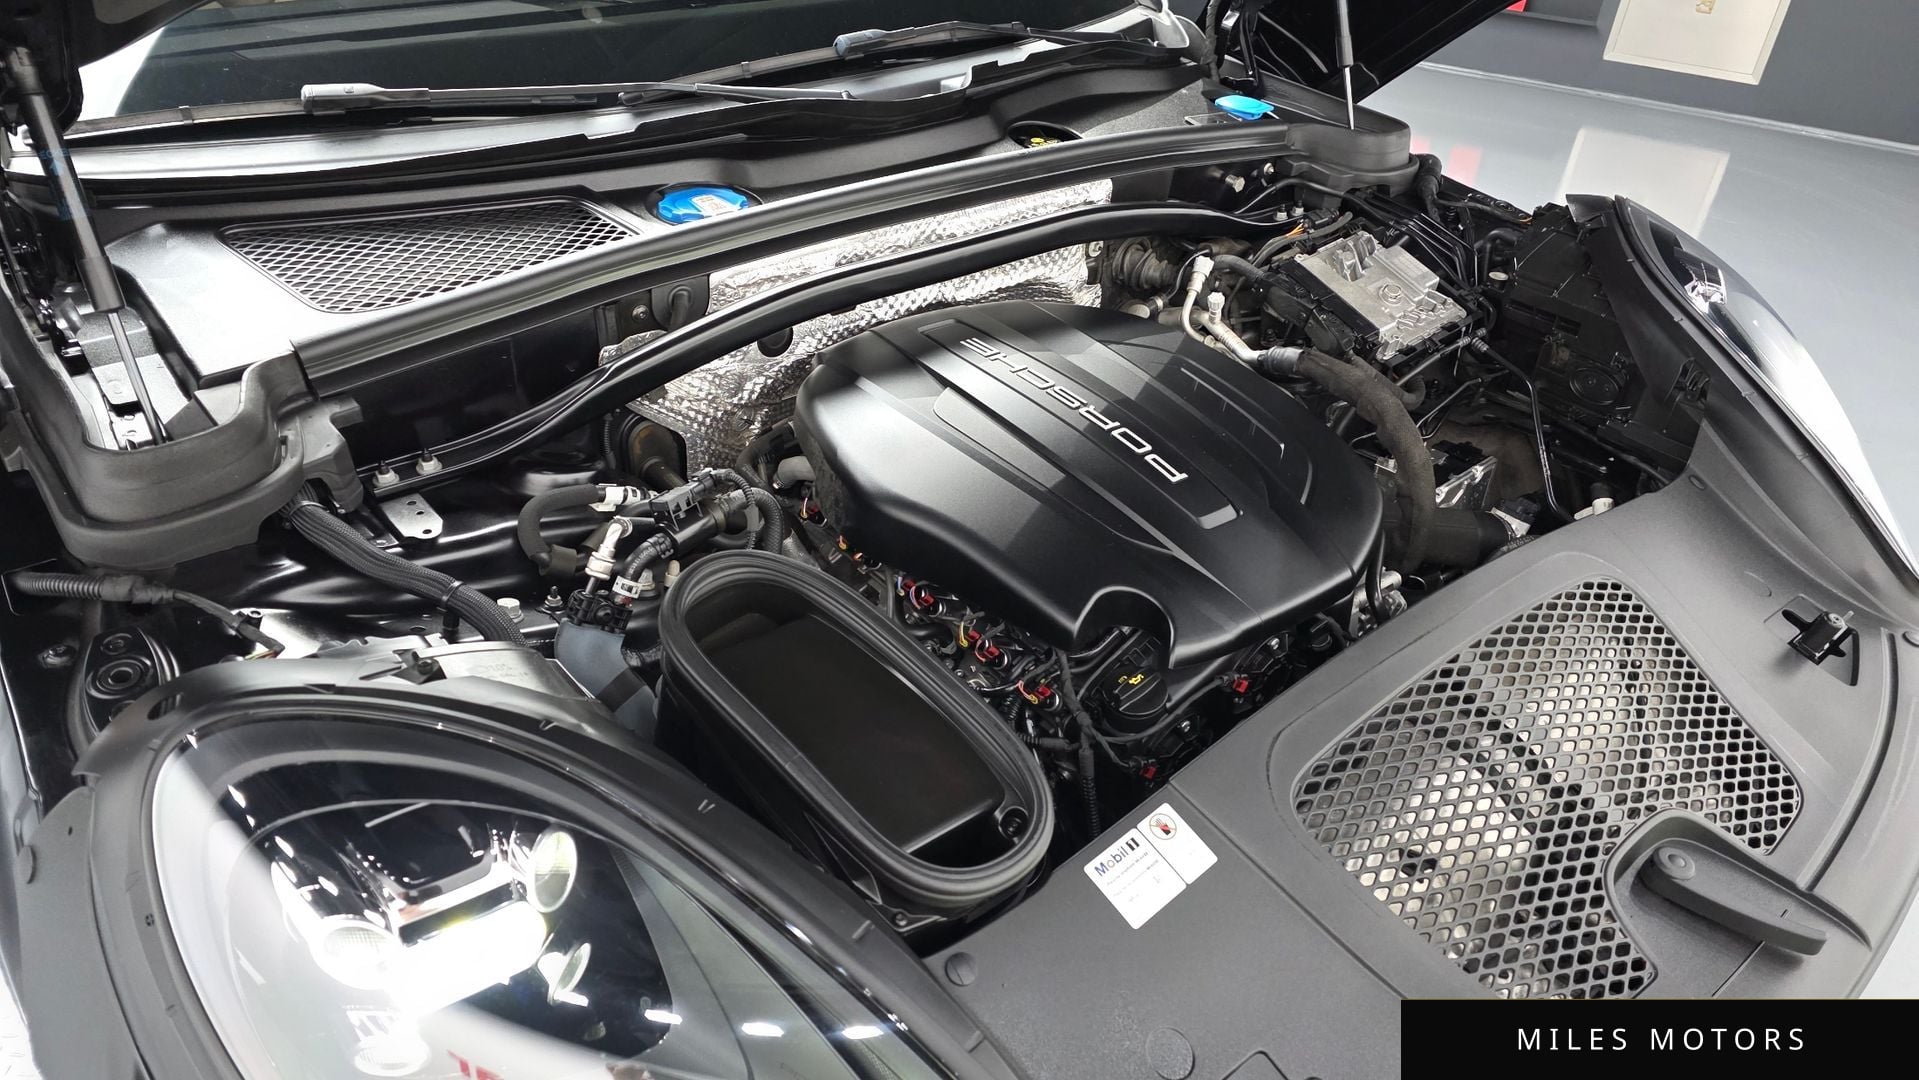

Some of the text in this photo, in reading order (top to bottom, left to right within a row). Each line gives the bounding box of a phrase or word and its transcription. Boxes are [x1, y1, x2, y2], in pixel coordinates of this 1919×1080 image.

[959, 337, 1189, 483] PORSCHE
[1094, 846, 1129, 877] Mobil
[1125, 837, 1140, 852] 1
